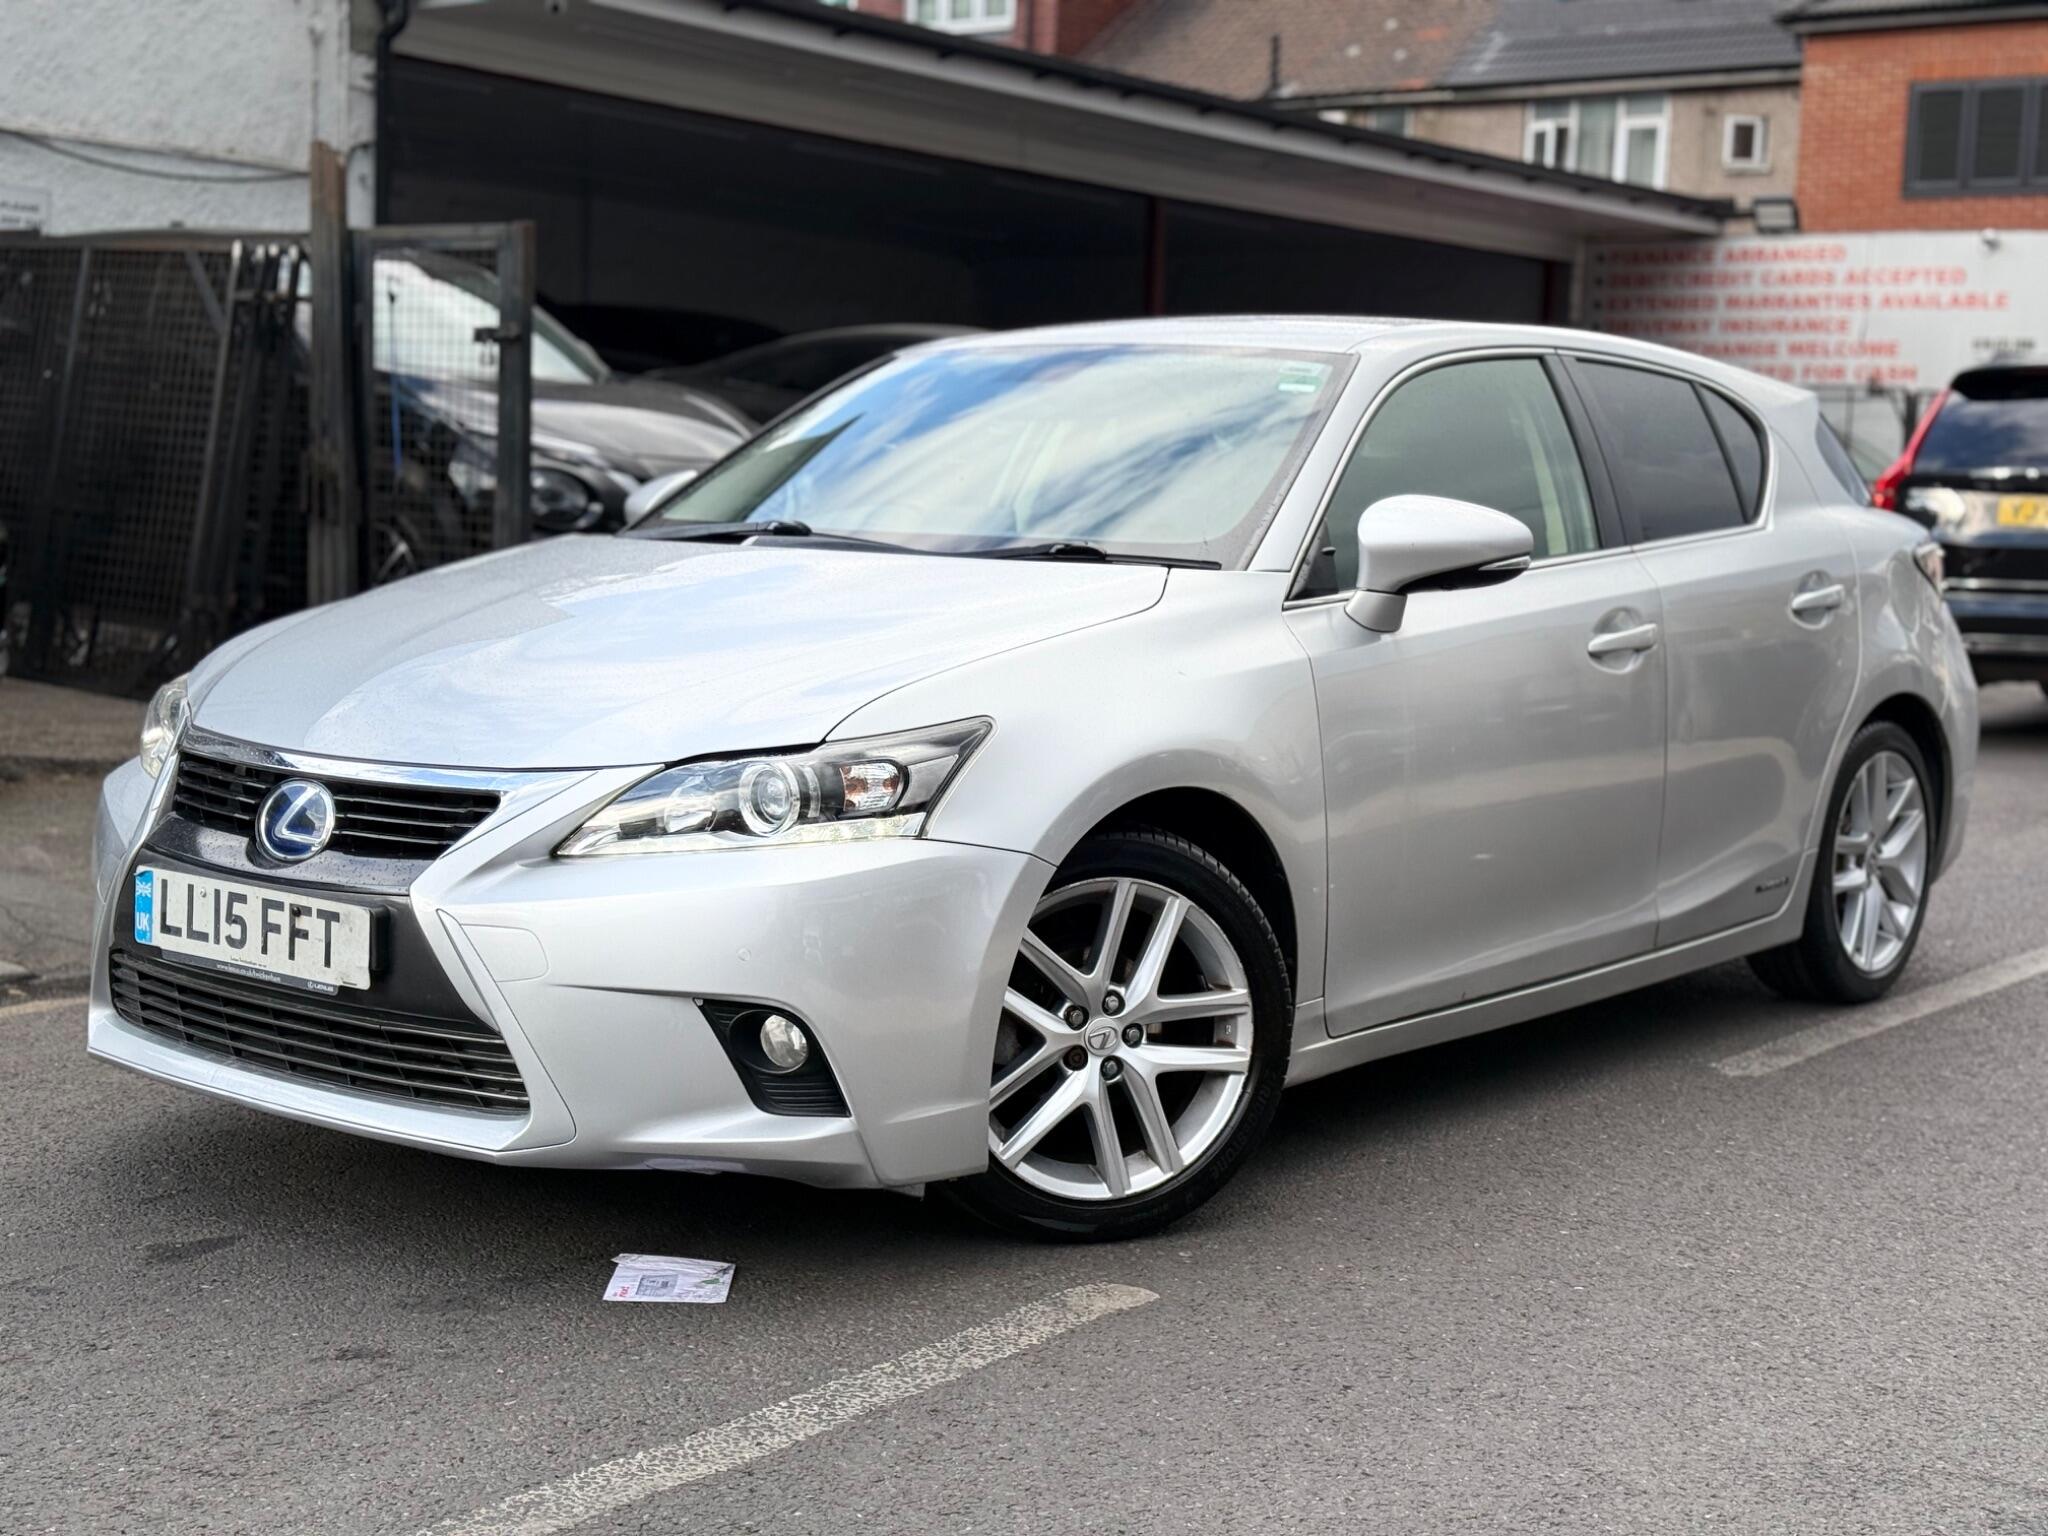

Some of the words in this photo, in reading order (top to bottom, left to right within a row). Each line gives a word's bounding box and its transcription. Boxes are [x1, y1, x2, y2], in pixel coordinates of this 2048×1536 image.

[1723, 245, 1847, 263] ARRANGED
[1760, 268, 1835, 286] CARDS
[1845, 268, 1967, 286] ACCEPTED
[1605, 294, 1718, 312] EXTENDED
[1724, 293, 1872, 311] WARRANTIES
[1880, 293, 2009, 310] AVAILABLE
[1719, 317, 1851, 335] INSURANCE
[1786, 340, 1899, 358] WELCOME
[1801, 364, 1846, 382] FOR
[1854, 364, 1918, 383] CASH
[136, 911, 150, 932] UK
[160, 878, 248, 950] LL15
[261, 897, 340, 968] FFT
